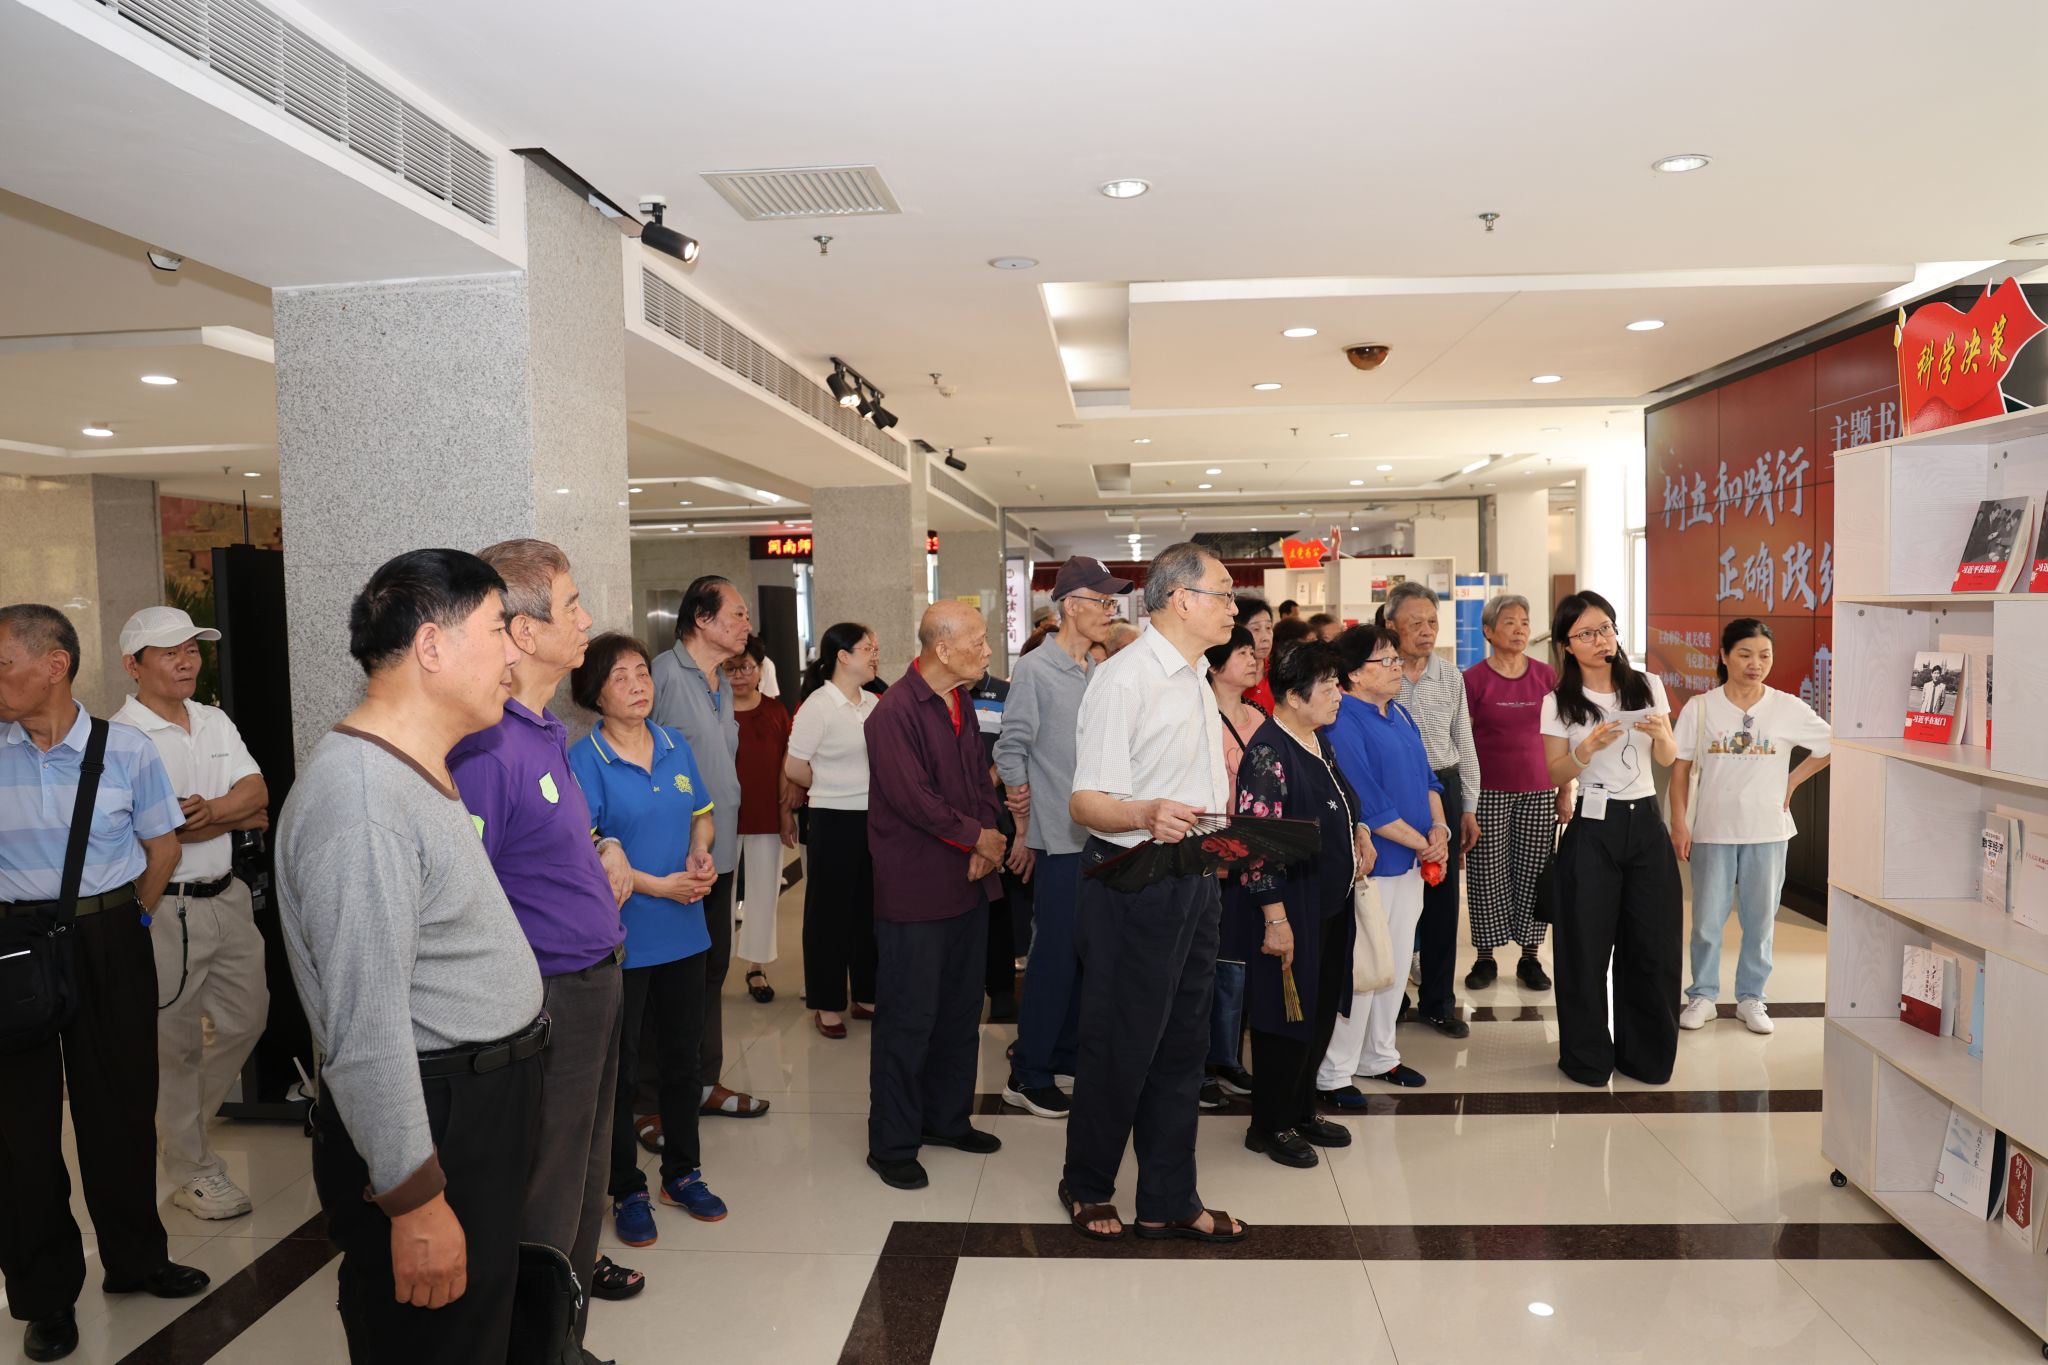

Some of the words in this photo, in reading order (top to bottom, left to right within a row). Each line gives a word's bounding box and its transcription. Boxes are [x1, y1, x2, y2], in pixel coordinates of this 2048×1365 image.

[1917, 314, 2007, 391] 科学决策
[1829, 402, 1904, 450] 主题书
[1662, 446, 1810, 532] 树立和践行
[768, 539, 812, 555] 闽南师
